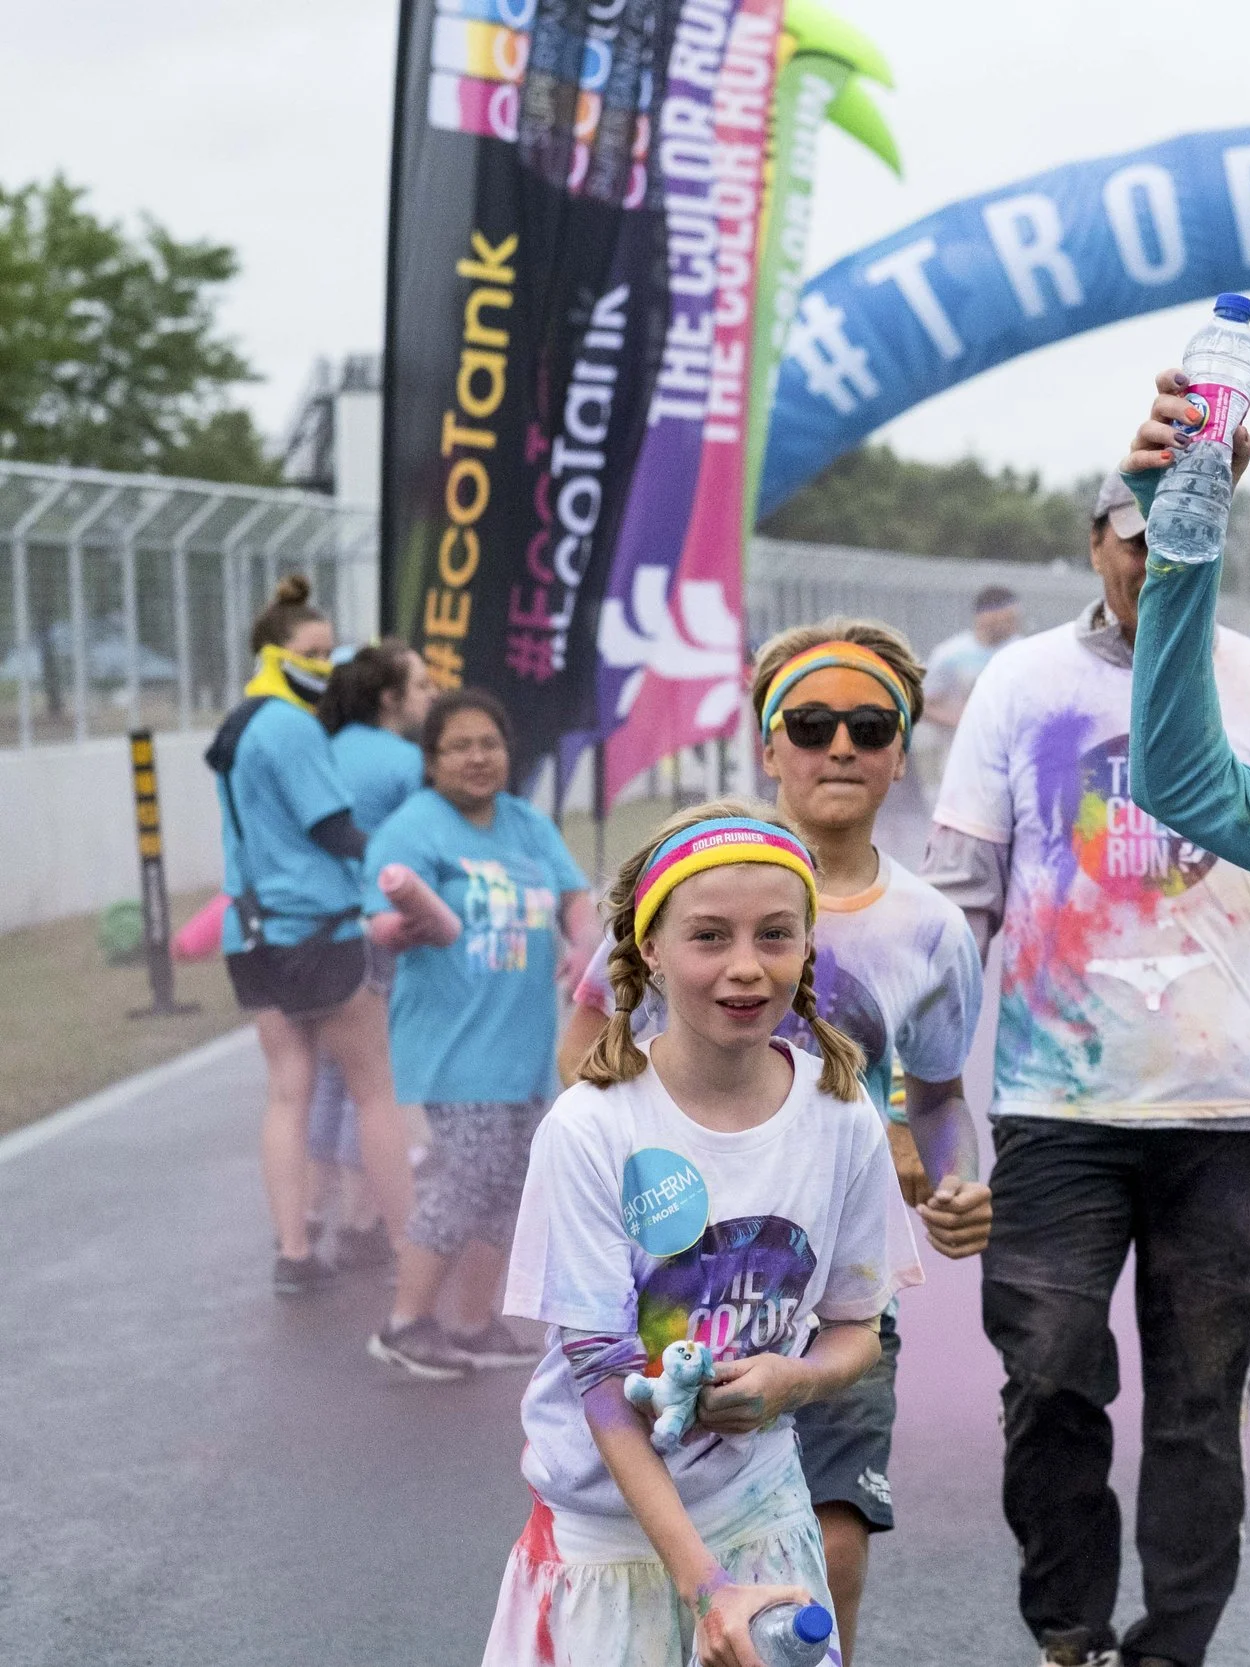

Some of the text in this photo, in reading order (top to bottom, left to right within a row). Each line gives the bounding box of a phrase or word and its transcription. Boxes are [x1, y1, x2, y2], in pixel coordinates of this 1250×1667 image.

[646, 308, 716, 428] THE
[424, 230, 519, 688] #EcoTank
[692, 832, 764, 853] COLOR RUNNER
[1106, 837, 1171, 878] RUN
[623, 1165, 699, 1226] BIOTHERM
